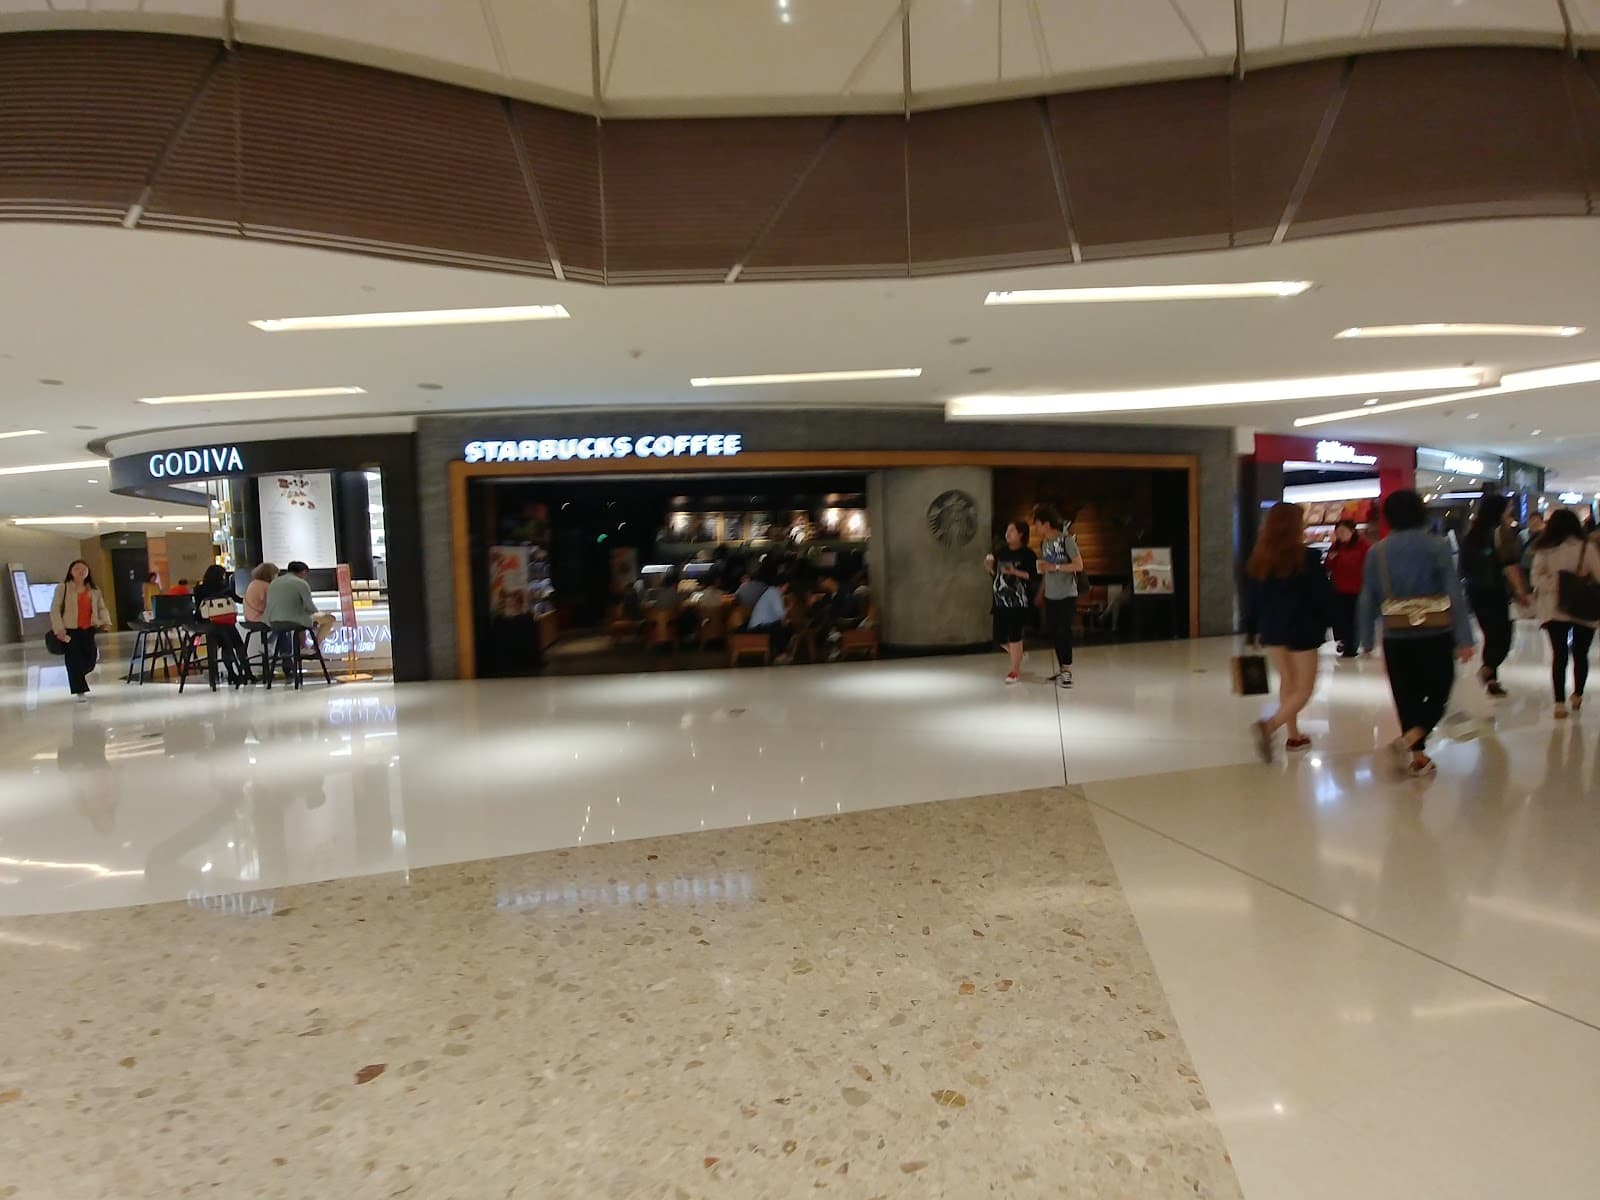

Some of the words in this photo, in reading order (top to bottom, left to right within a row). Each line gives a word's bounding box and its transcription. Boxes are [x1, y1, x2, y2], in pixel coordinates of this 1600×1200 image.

[149, 446, 244, 478] GODIVA
[464, 437, 633, 463] STARBUCKS
[635, 434, 742, 457] COFFEE
[324, 625, 391, 641] ODIVA
